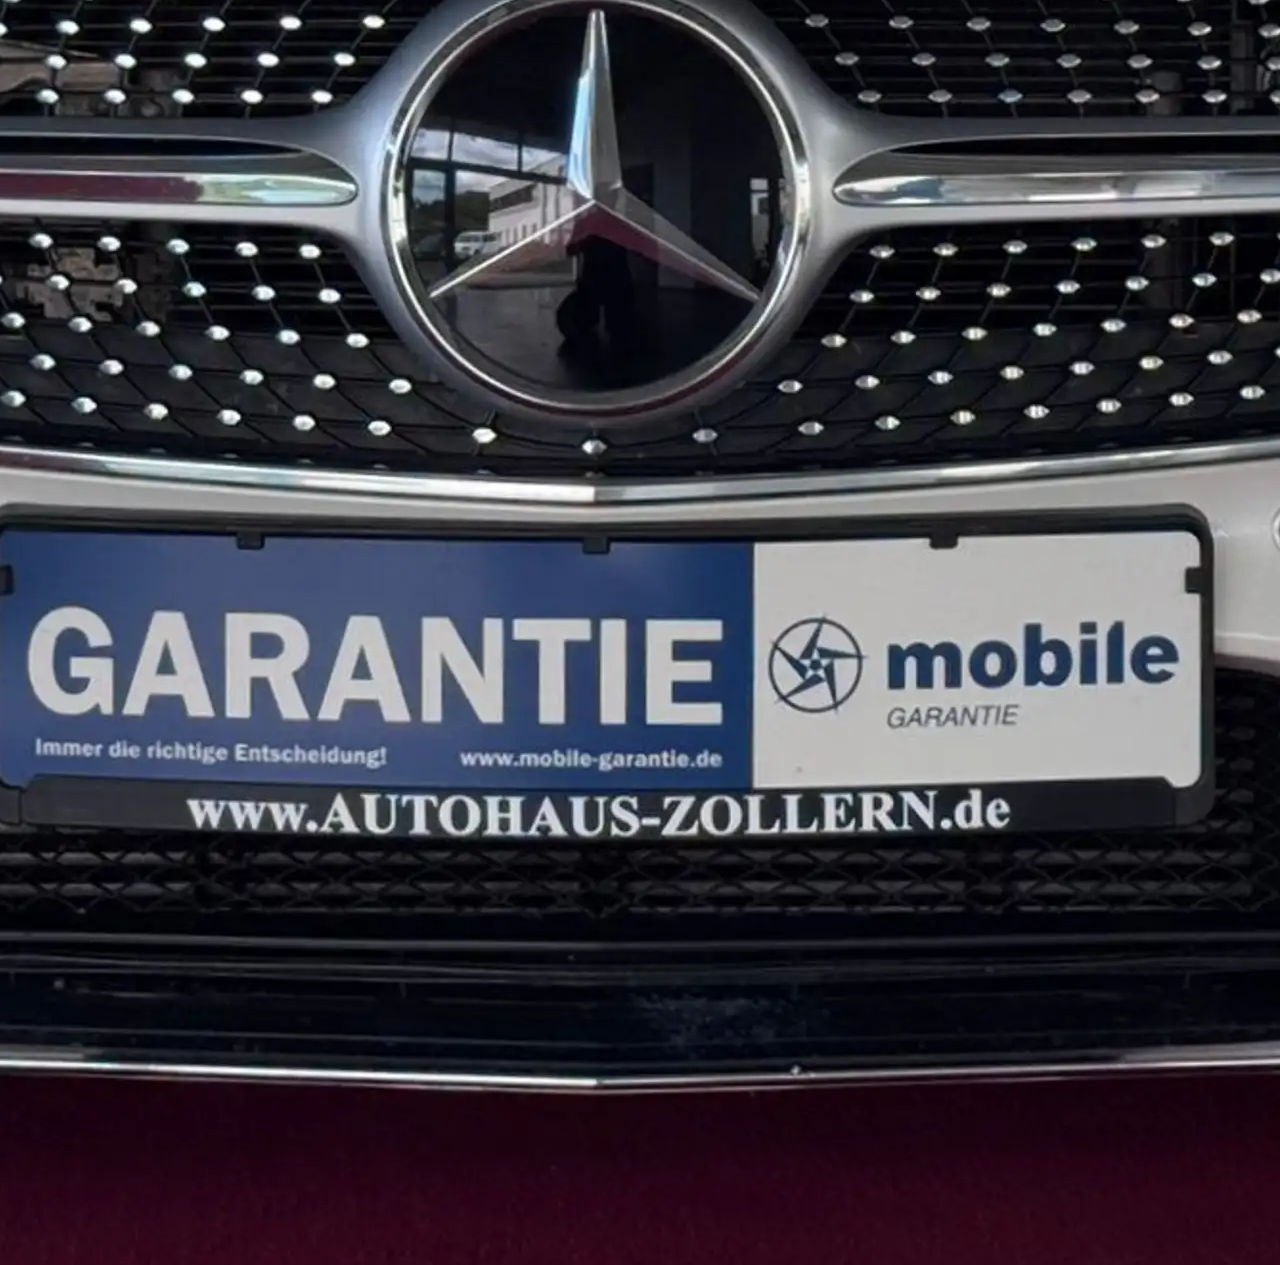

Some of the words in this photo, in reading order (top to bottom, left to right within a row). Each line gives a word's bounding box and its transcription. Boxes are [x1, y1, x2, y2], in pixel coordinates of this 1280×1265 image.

[27, 606, 724, 725] GARANTIE
[888, 621, 1180, 690] mobile
[887, 704, 1019, 729] GARANTIE
[34, 737, 103, 759] Immer
[108, 739, 141, 760] die
[146, 741, 229, 765] richtige
[235, 743, 388, 768] Entscheidung!
[459, 746, 724, 770] www.mobile-garantie.de
[186, 790, 1011, 837] www.AUTOHAUS-ZOLLERN.de
